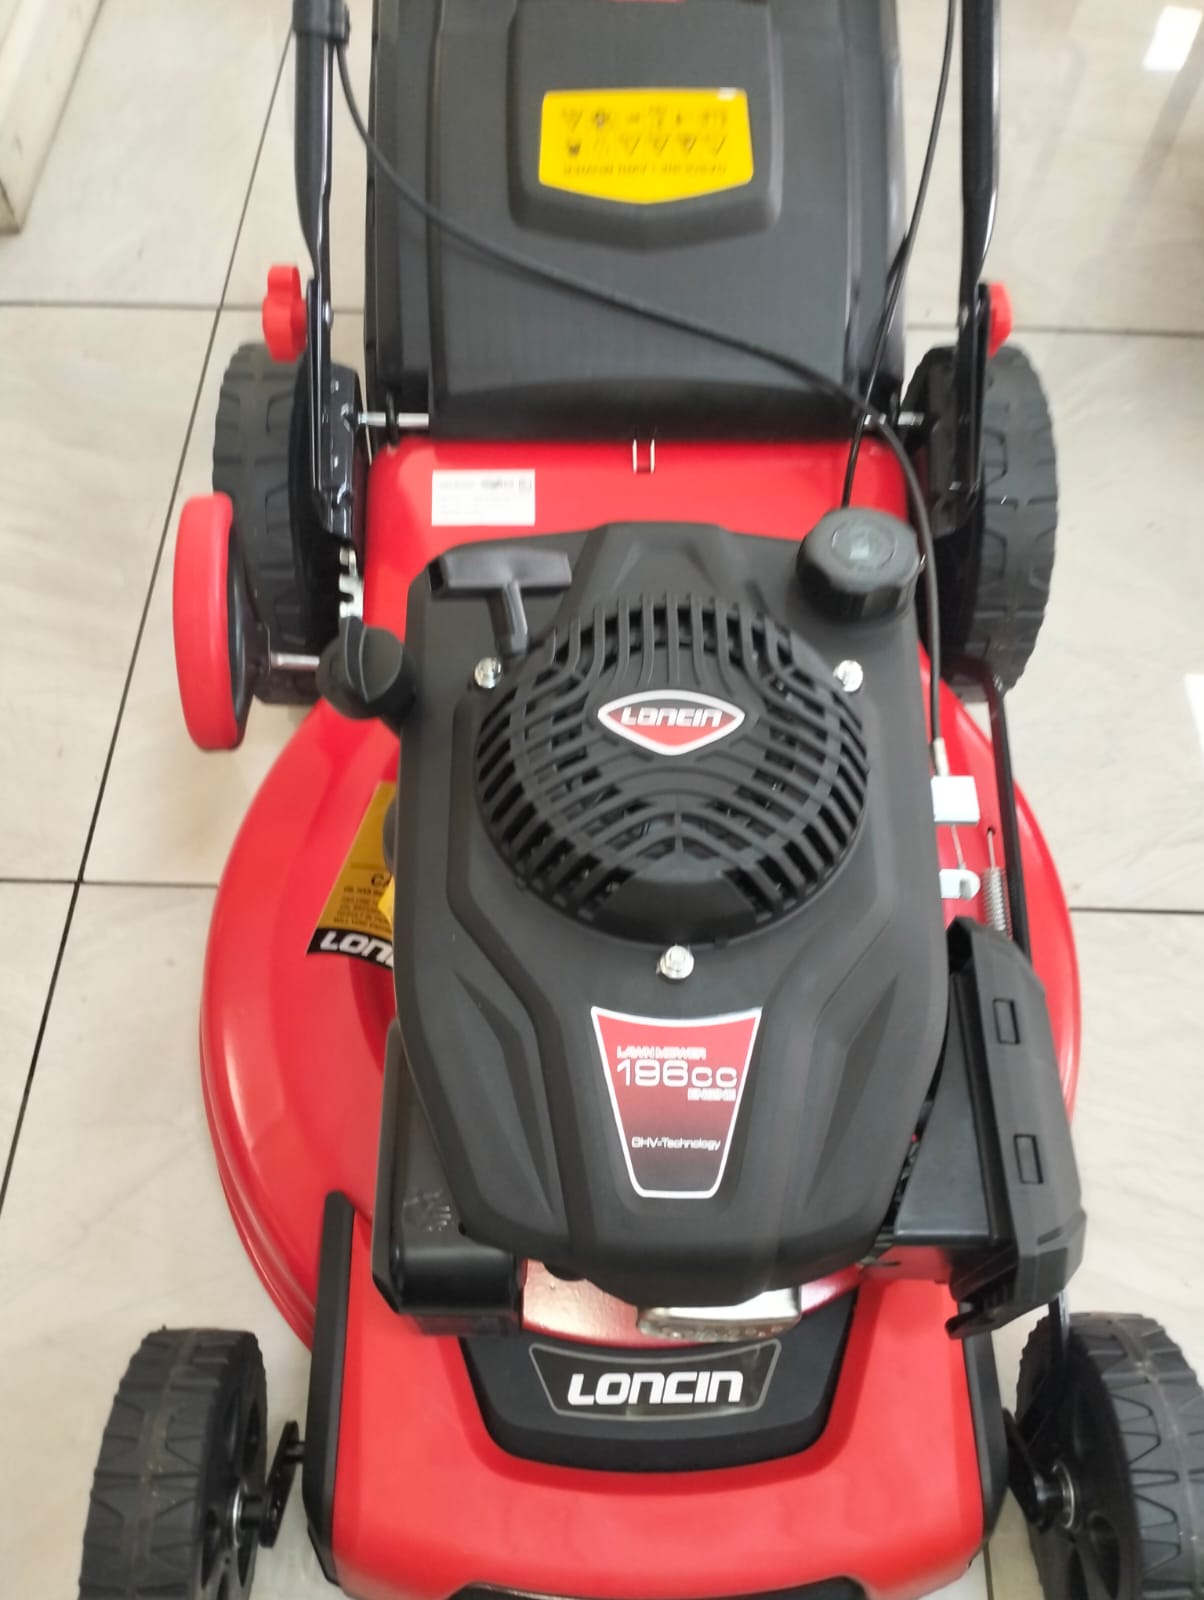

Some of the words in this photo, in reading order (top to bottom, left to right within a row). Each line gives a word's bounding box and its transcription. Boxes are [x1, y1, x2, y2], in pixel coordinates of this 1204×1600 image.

[620, 706, 723, 728] LONCIN
[320, 930, 394, 969] LON
[616, 1059, 738, 1088] 196cc
[567, 1370, 744, 1406] LONCIN
